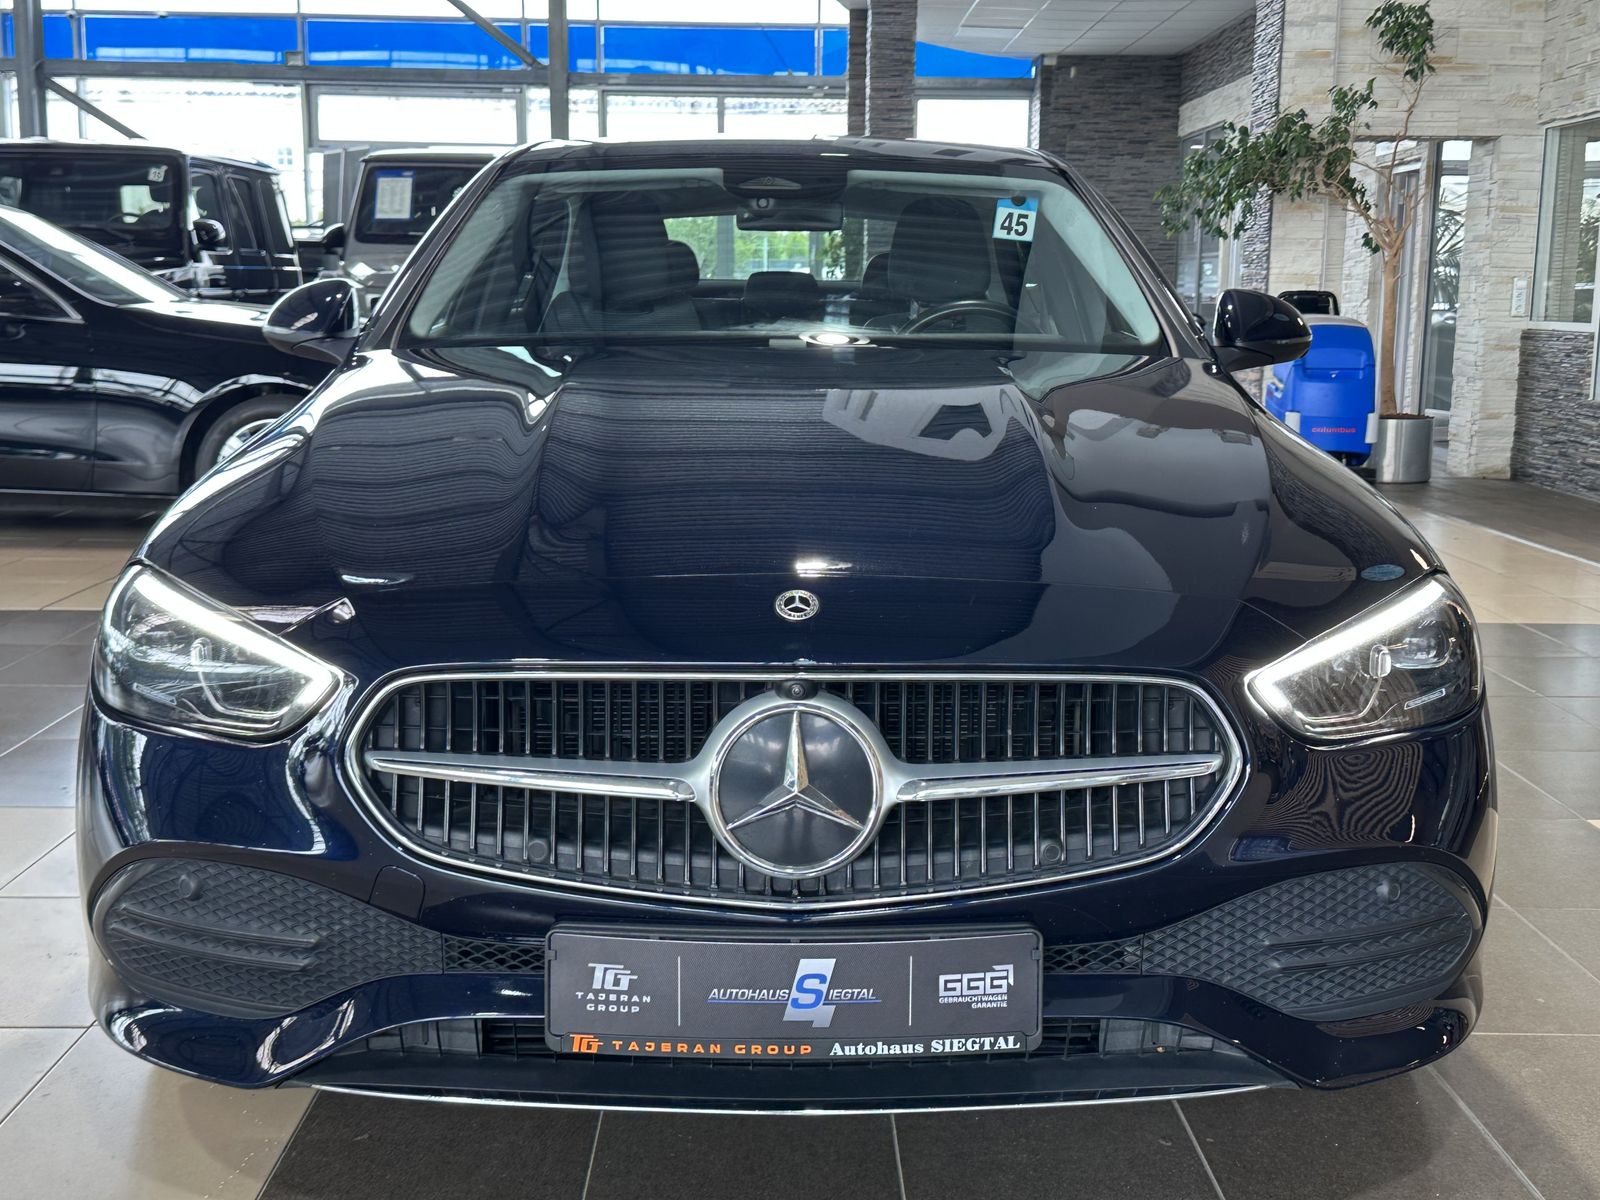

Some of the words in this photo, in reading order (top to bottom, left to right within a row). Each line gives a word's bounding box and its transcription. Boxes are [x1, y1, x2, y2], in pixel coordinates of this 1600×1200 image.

[1000, 212, 1029, 237] 45
[939, 971, 1008, 997] GGG
[575, 991, 651, 1003] TAJERAN
[708, 988, 790, 1001] AUTOHAUS
[938, 994, 1008, 1004] GEBRAUCHTWAGEN
[586, 1003, 640, 1013] GROUP
[971, 1001, 1008, 1009] GARANTIE
[612, 1040, 721, 1054] TAJERAN
[734, 1044, 813, 1056] GROUP
[829, 1041, 924, 1057] Autohaus
[930, 1036, 1021, 1054] SIEGTAL
